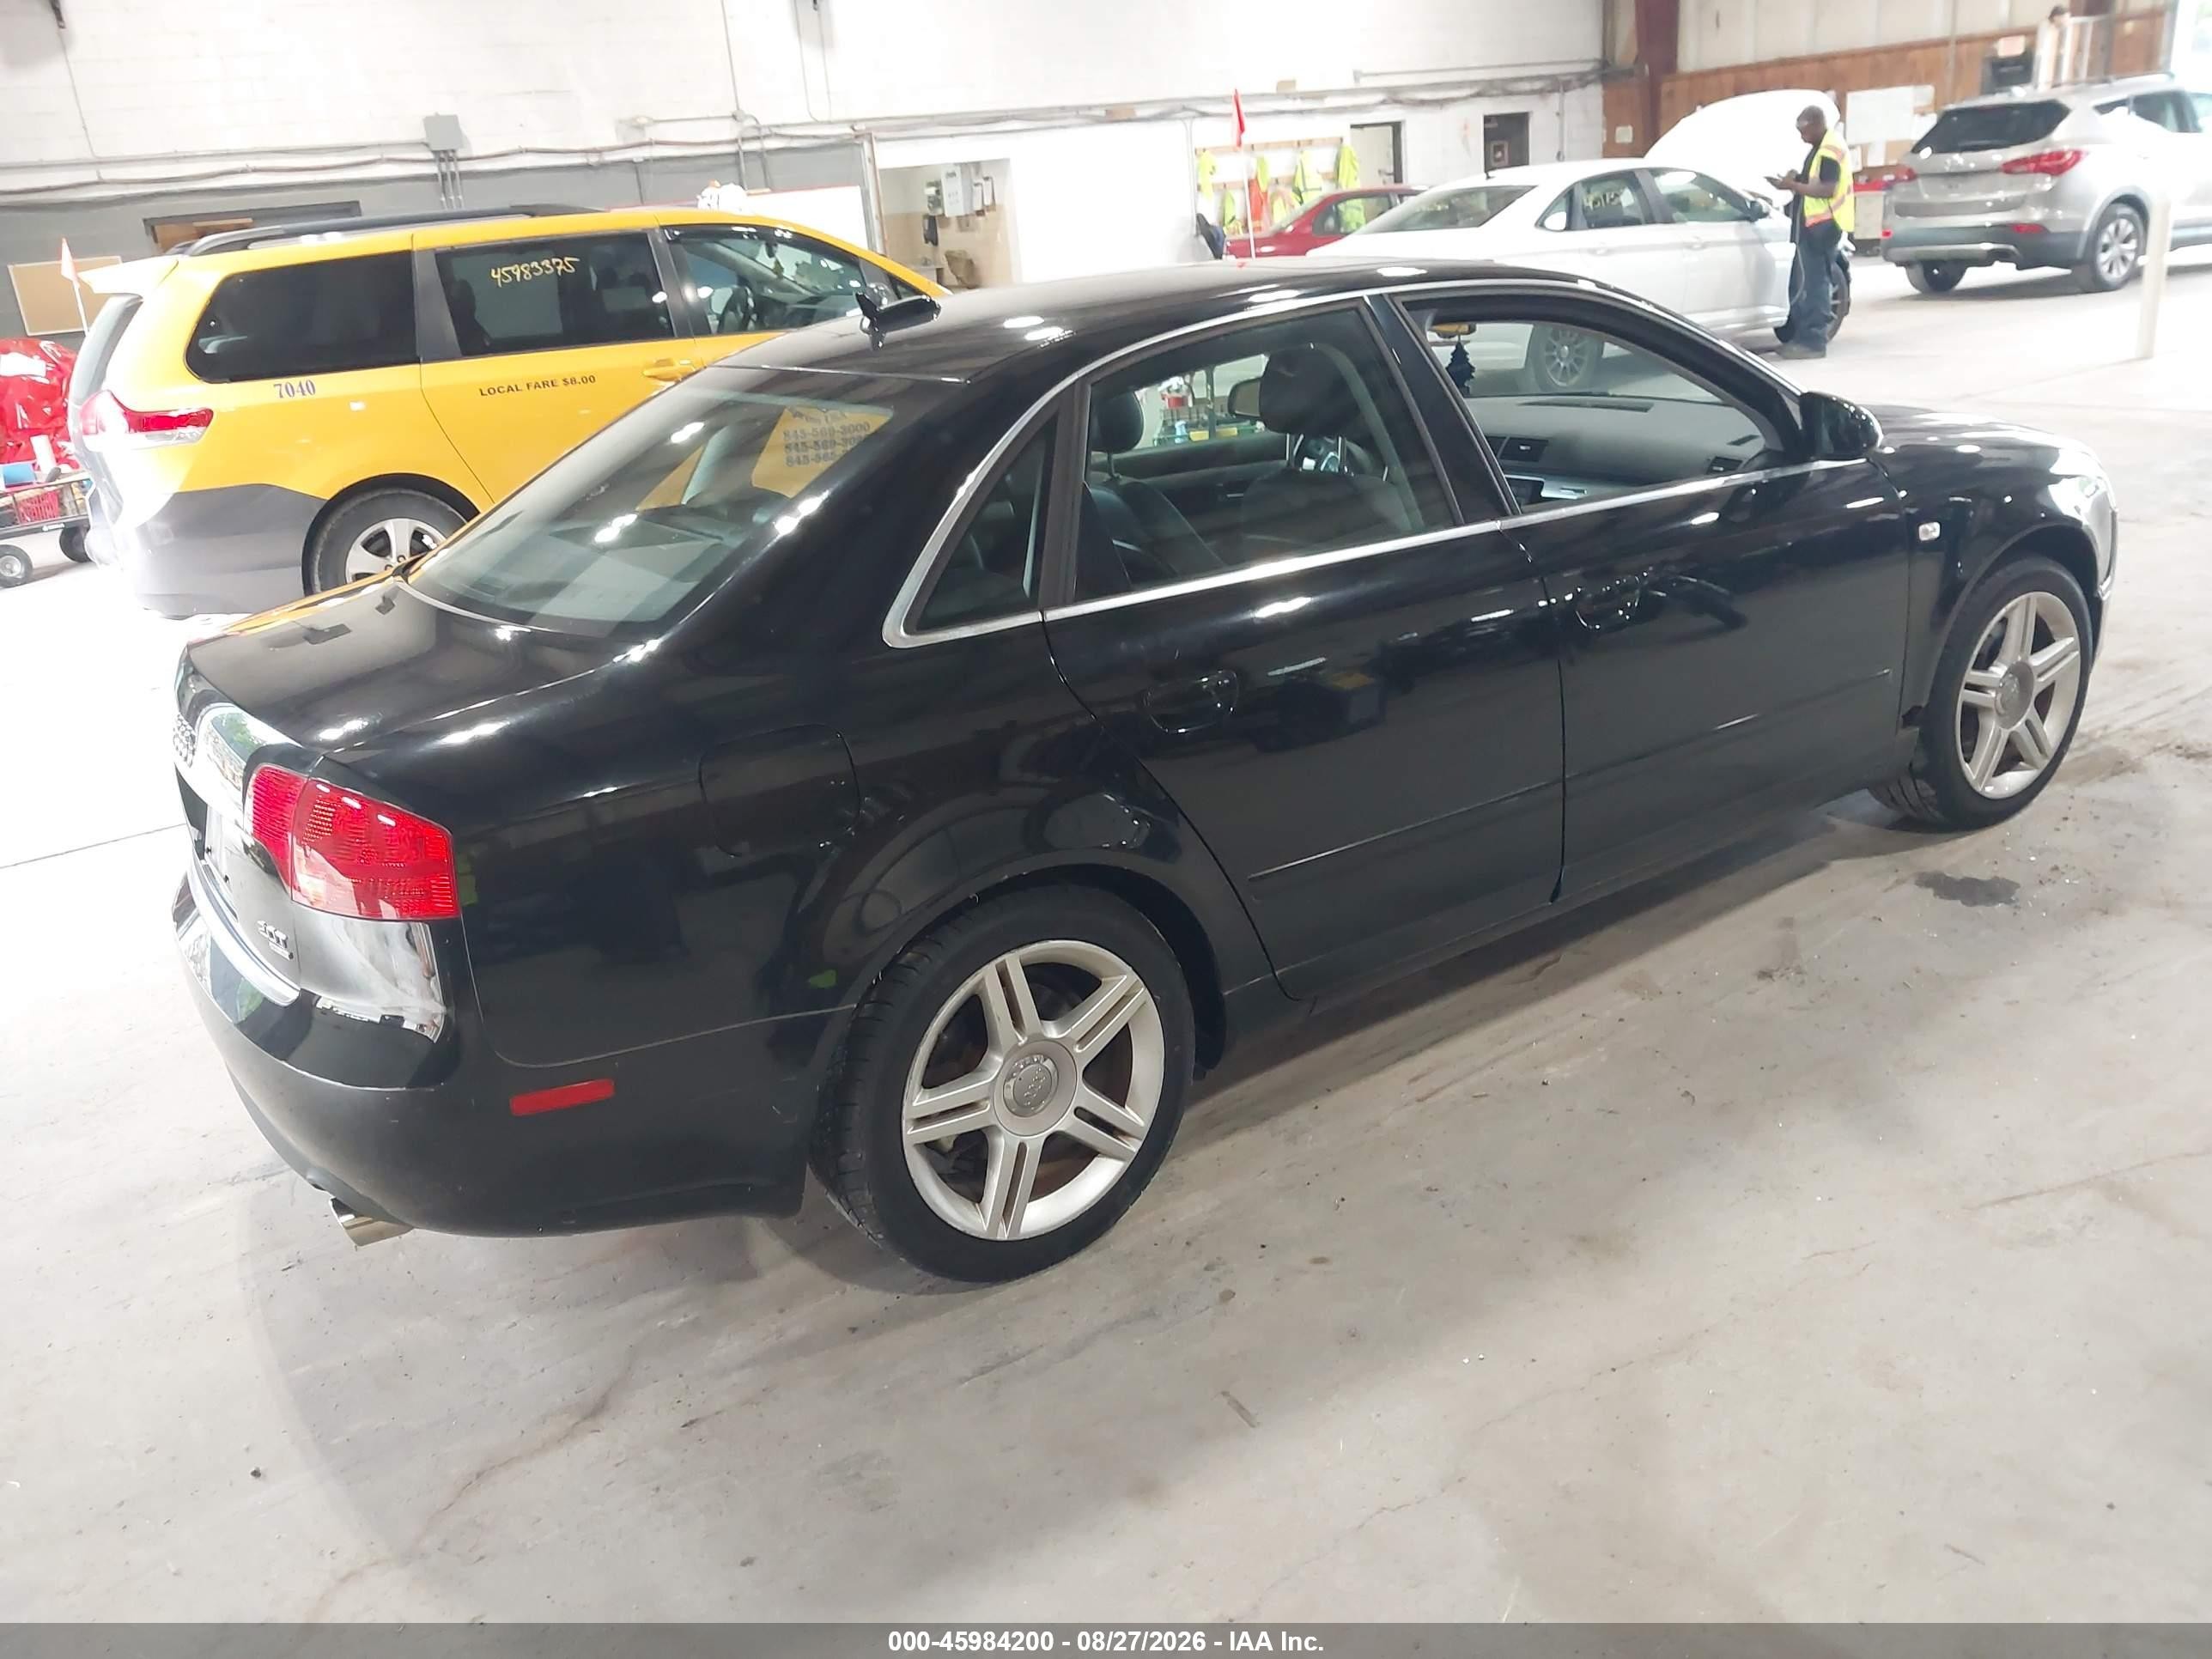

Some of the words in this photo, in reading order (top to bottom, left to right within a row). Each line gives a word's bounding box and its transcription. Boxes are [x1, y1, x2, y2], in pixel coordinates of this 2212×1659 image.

[490, 256, 580, 289] 45983375
[273, 379, 316, 399] 7040
[478, 384, 523, 397] LOCAL
[526, 379, 559, 391] FARE
[562, 374, 597, 386] $8.00
